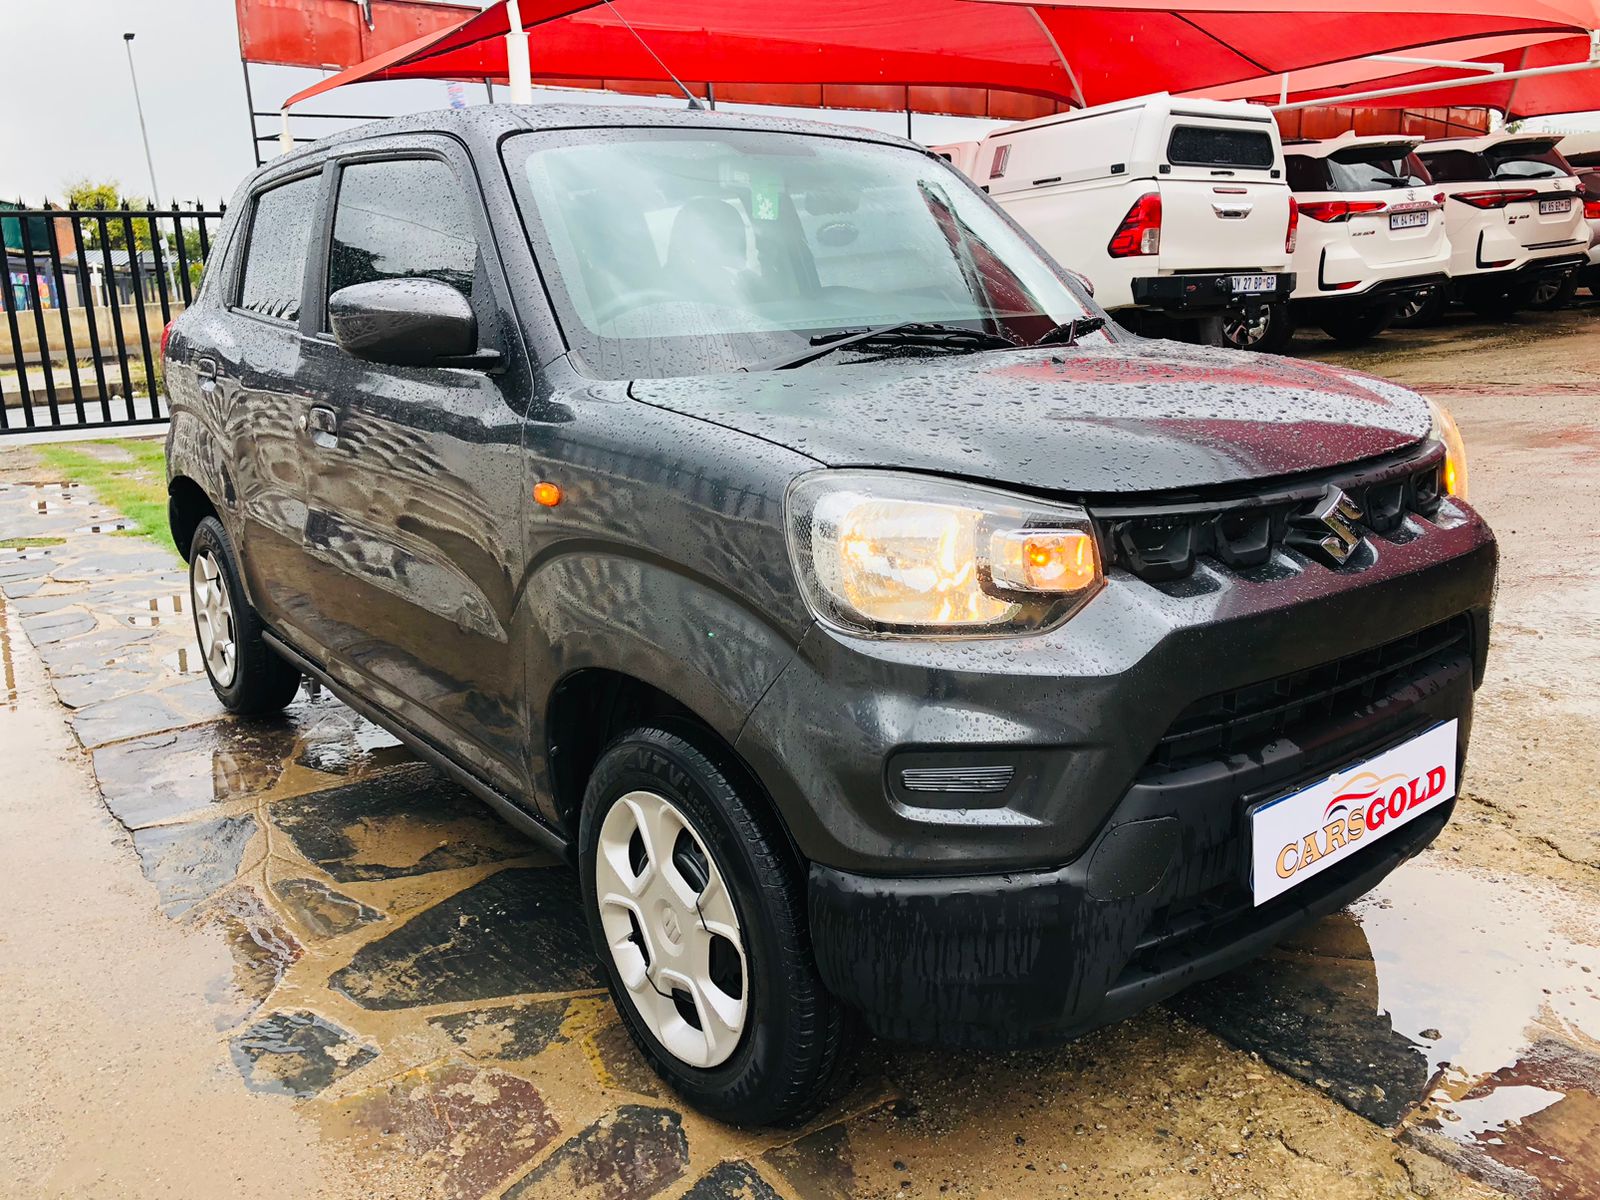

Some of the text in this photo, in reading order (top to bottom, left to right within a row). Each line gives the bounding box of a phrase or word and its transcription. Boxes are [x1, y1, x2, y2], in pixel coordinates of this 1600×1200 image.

[1232, 277, 1241, 290] JY
[1243, 277, 1252, 290] 27
[1266, 276, 1275, 289] GP
[1275, 765, 1446, 879] CARSGOLD
